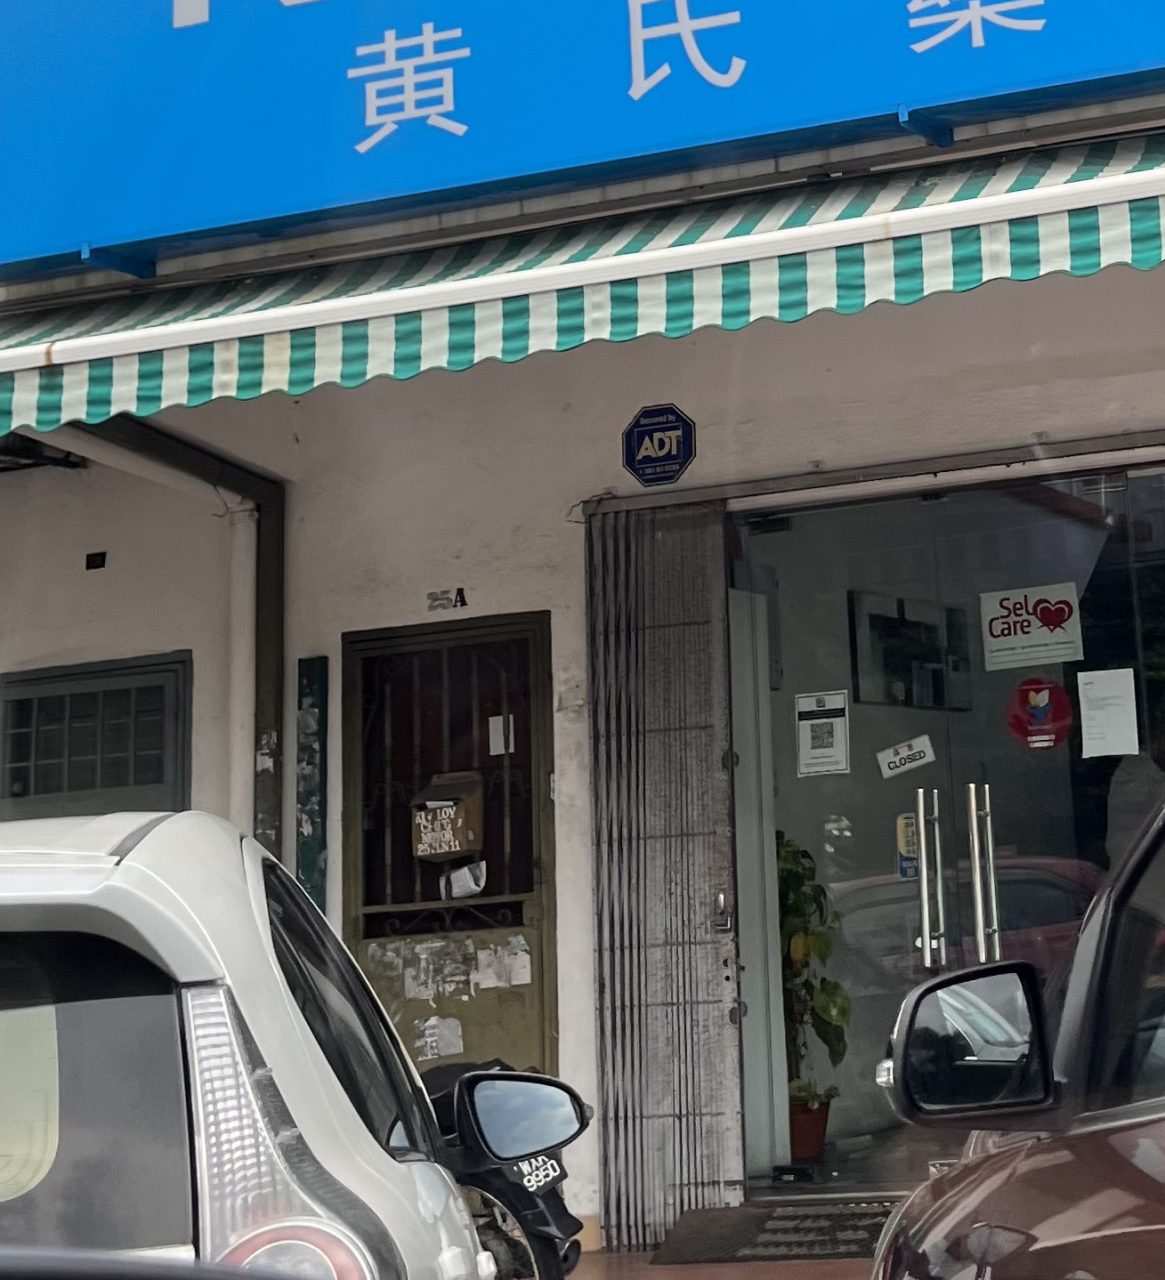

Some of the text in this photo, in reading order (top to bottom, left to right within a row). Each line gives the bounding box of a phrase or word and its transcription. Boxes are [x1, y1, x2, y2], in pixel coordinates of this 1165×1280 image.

[635, 429, 682, 460] ADT
[426, 588, 468, 612] 25A
[999, 595, 1035, 618] Sel
[989, 616, 1031, 638] Care
[888, 750, 926, 771] CLOSED
[523, 1160, 560, 1191] 9950
